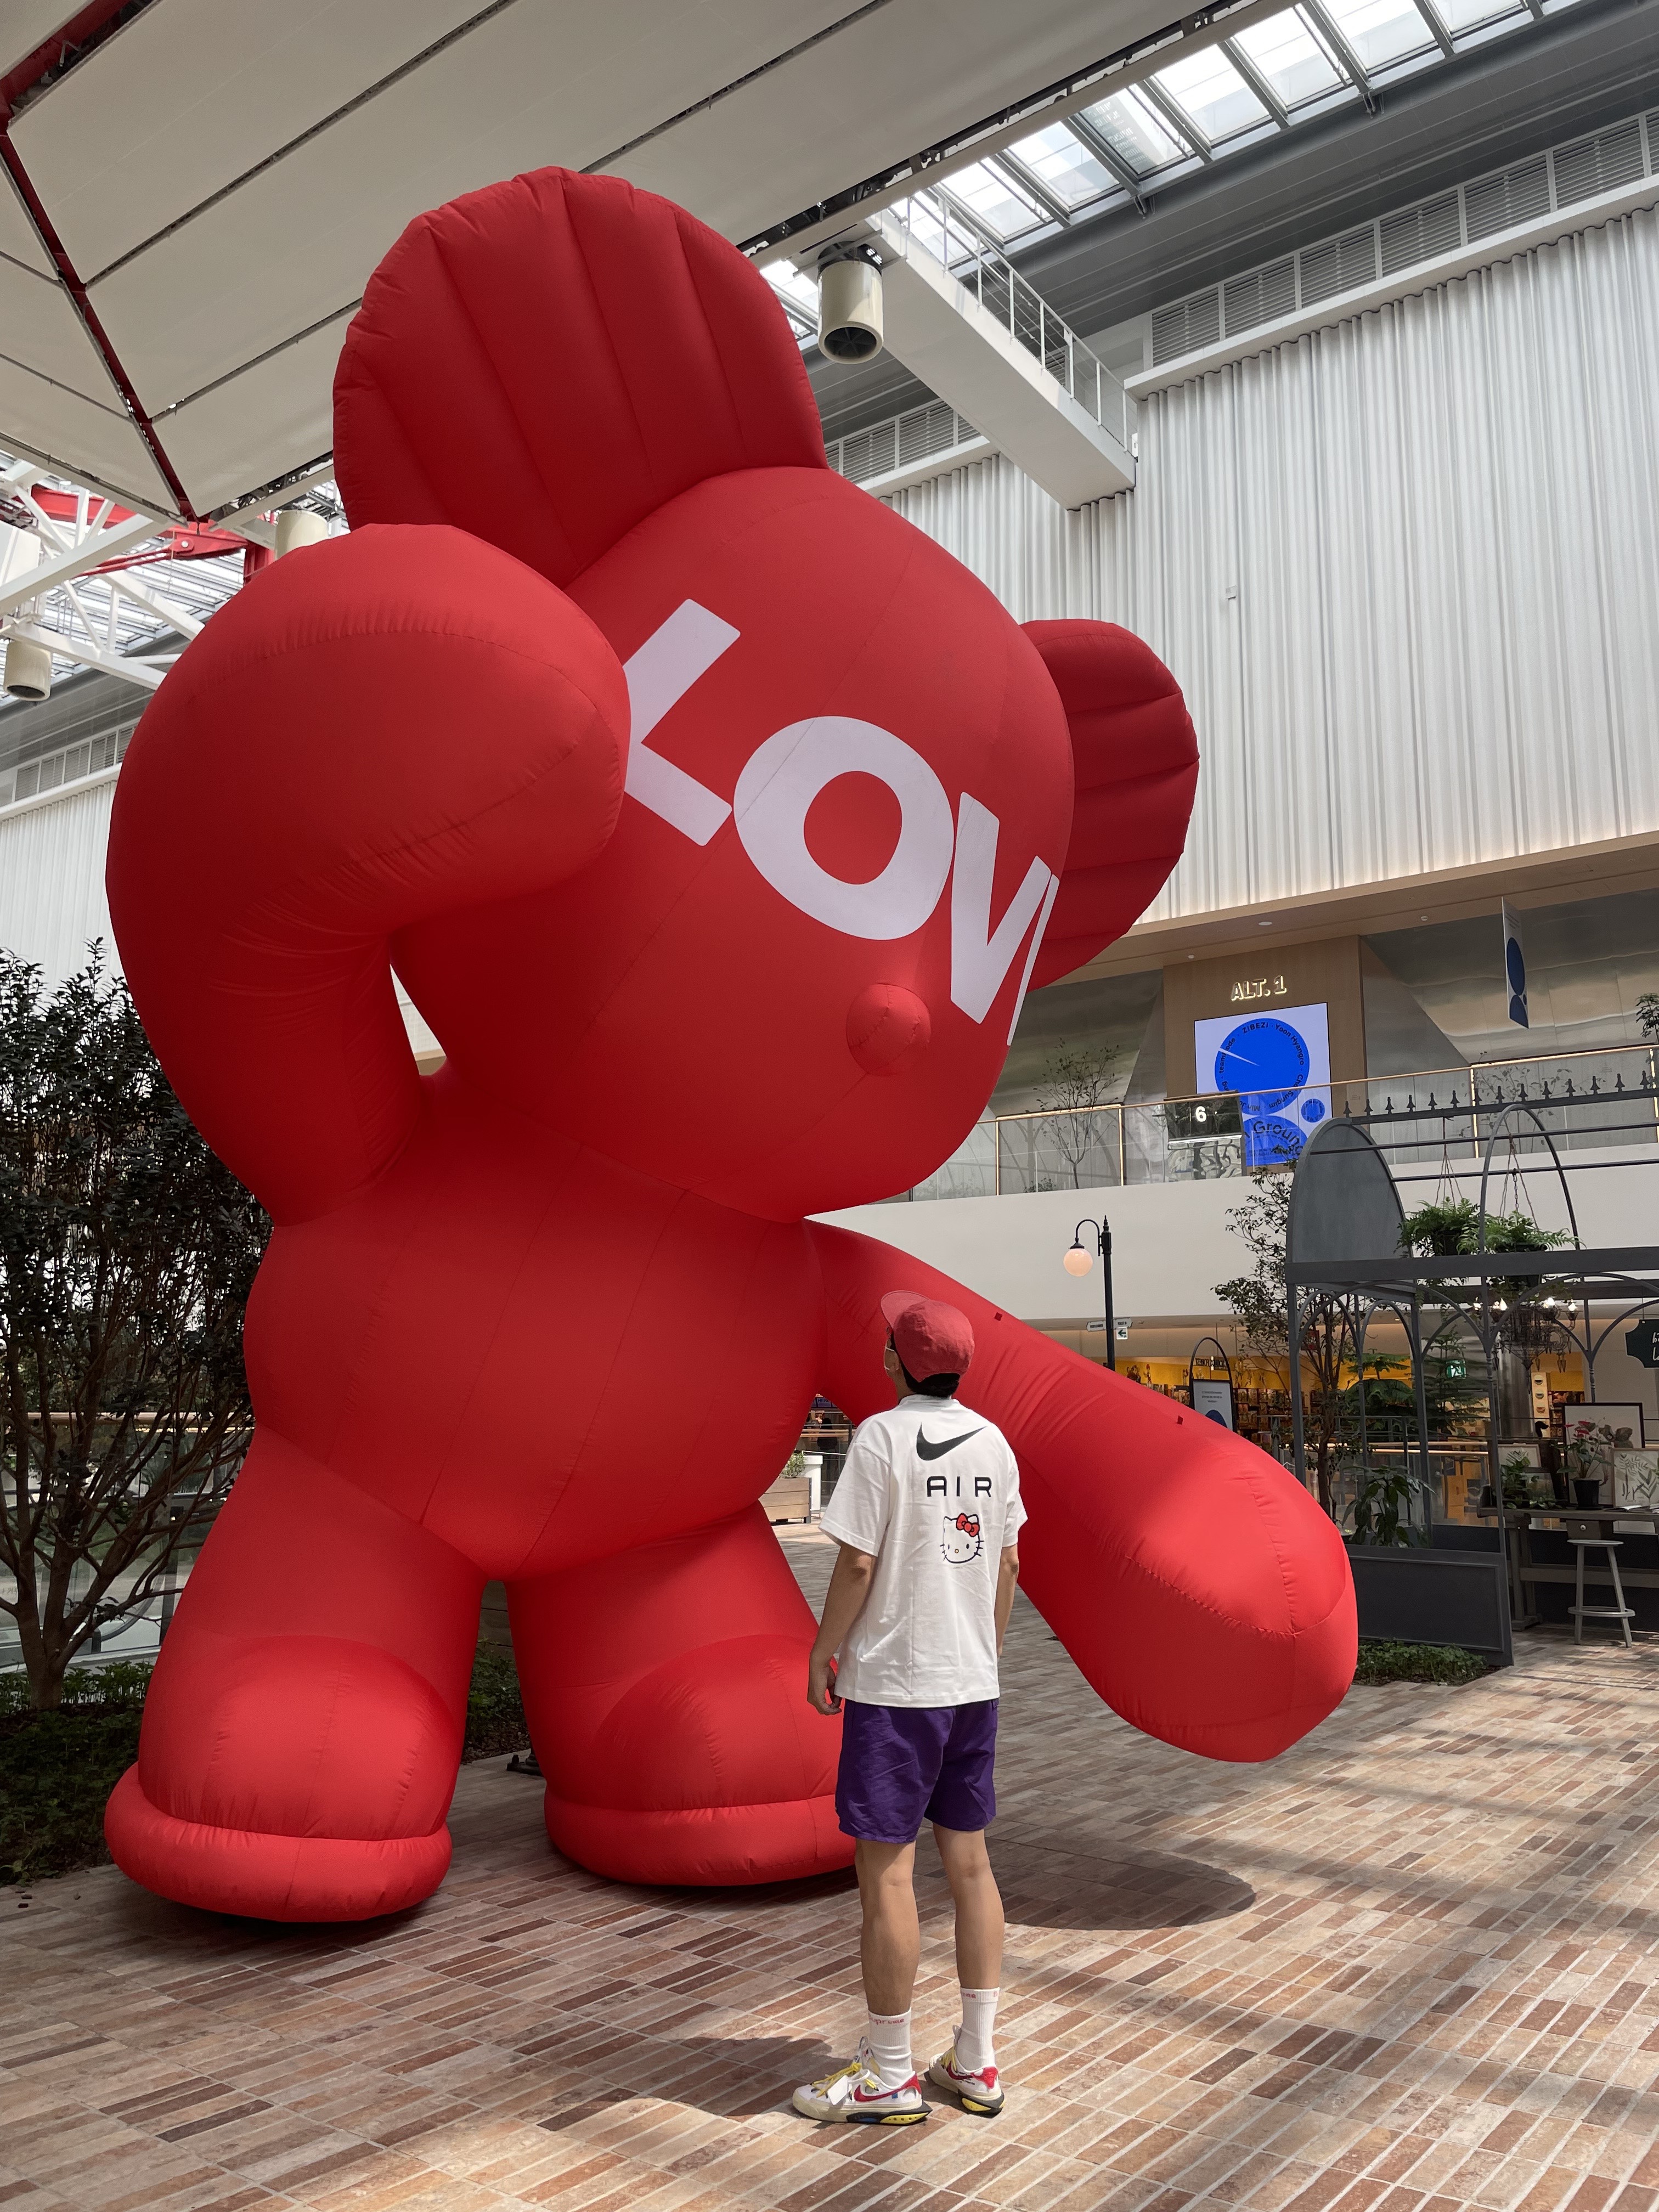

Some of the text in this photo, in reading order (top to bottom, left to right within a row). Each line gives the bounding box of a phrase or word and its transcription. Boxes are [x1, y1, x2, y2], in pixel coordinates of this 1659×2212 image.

[622, 599, 1059, 1046] LOV
[1242, 1022, 1268, 1034] ZIBEZI
[1275, 1023, 1305, 1065] Yoon Hyangro
[1195, 1106, 1207, 1122] 6
[927, 1476, 992, 1497] AIR
